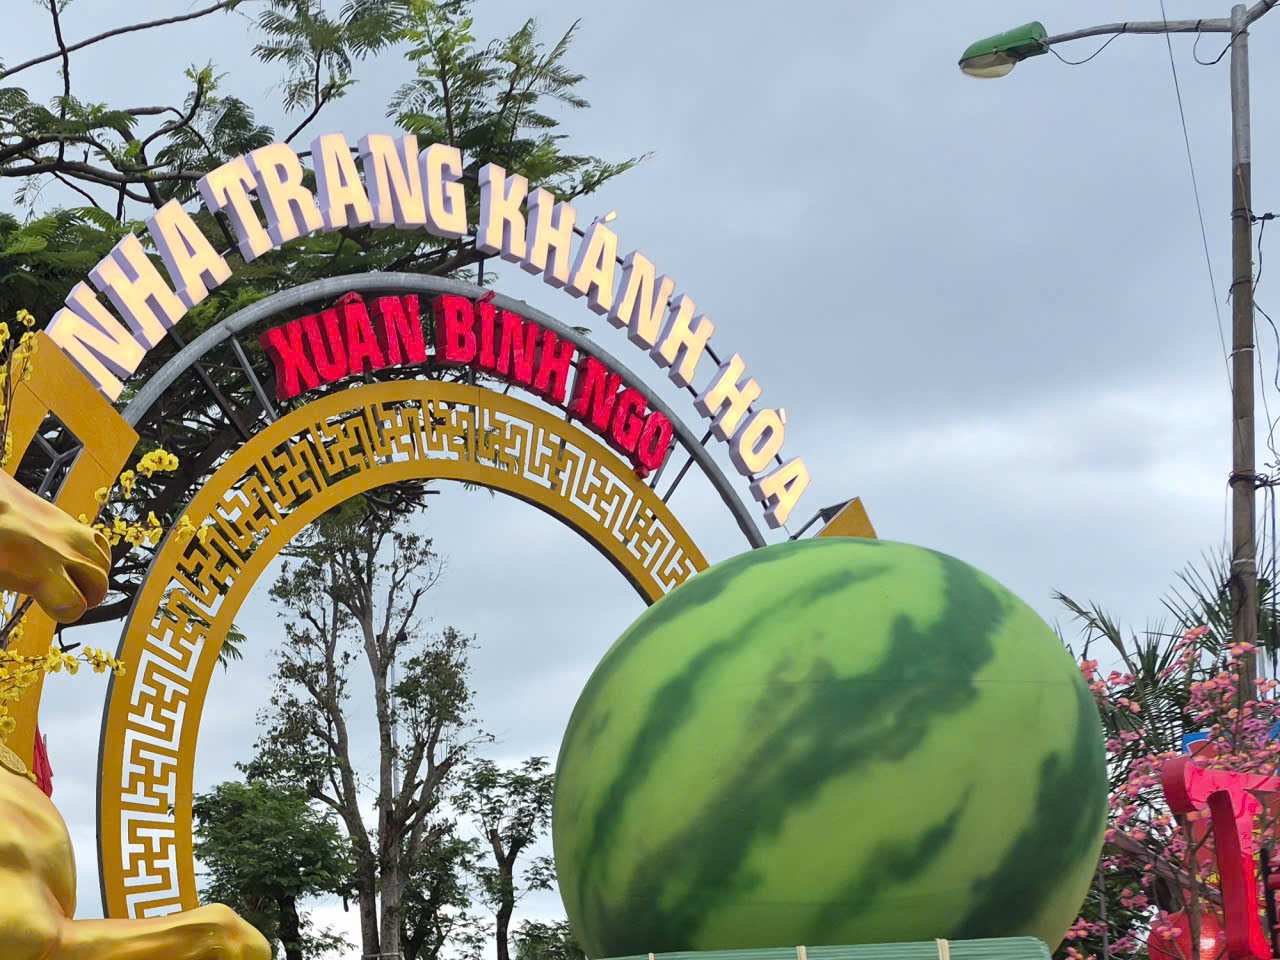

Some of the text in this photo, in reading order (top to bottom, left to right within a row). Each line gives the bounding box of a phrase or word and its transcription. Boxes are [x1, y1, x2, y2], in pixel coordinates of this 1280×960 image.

[44, 133, 812, 530] NHA TRANG KHÁNH HÒA
[259, 290, 674, 479] XUÂN BÍNH NGỌ
